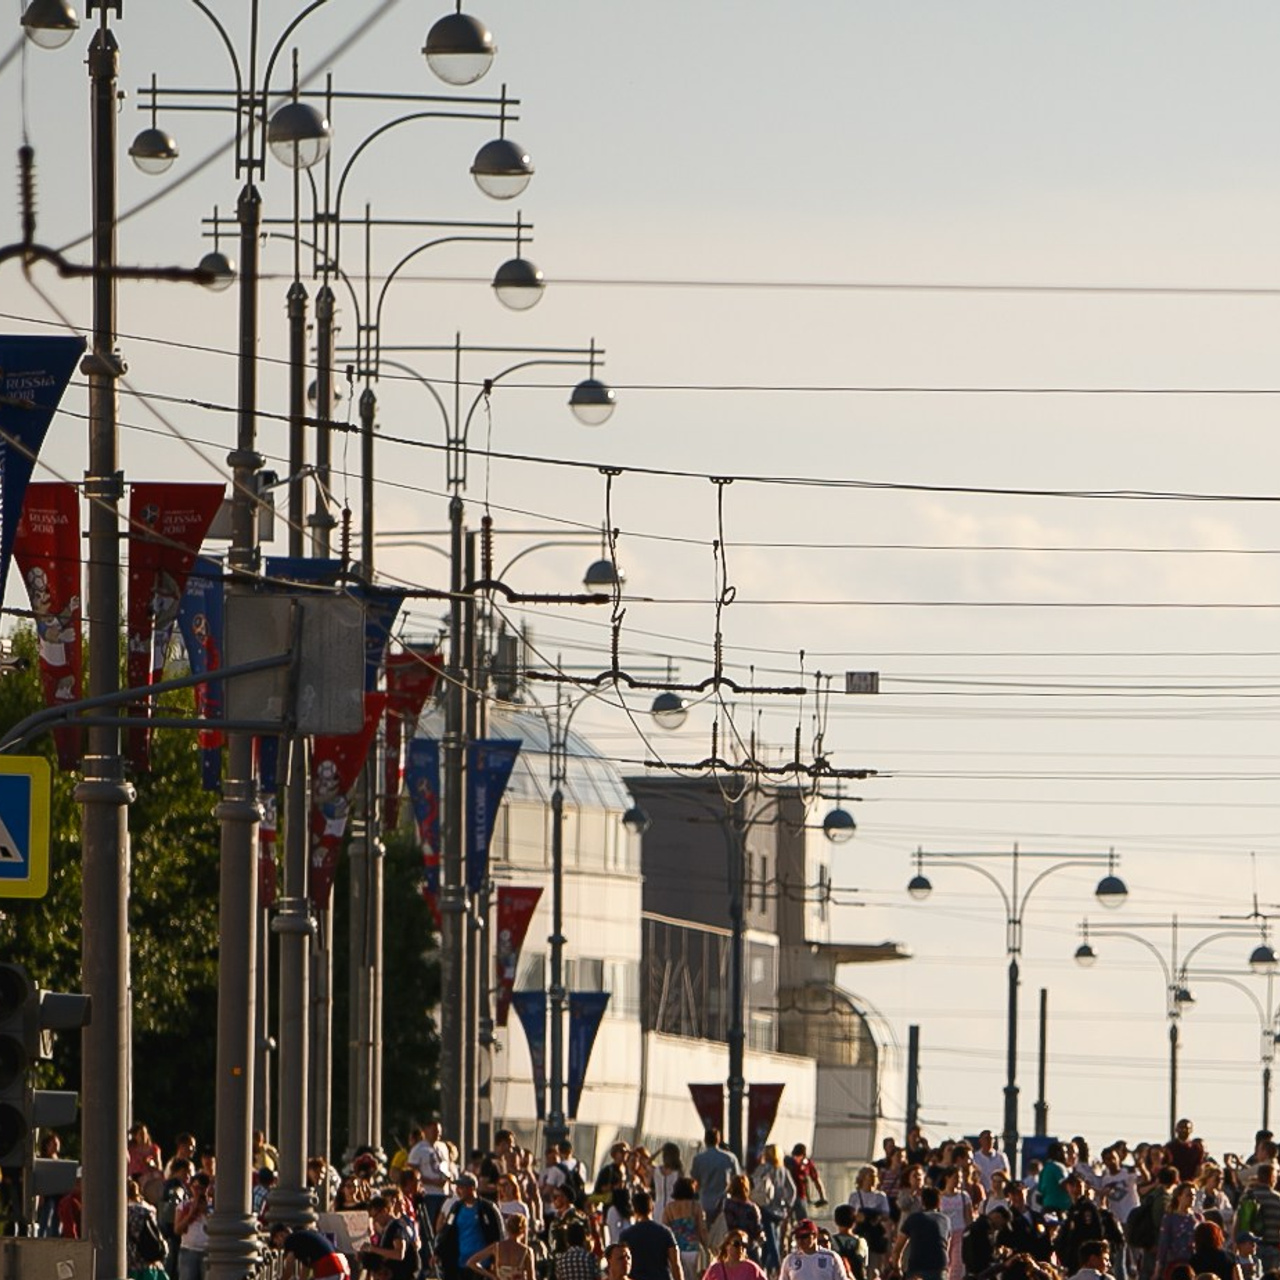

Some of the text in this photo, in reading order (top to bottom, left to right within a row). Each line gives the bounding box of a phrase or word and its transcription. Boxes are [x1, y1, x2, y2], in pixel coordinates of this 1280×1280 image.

[6, 376, 55, 389] RUSSIA
[29, 513, 69, 525] RUSSIA
[162, 514, 202, 526] RUSSIA
[32, 523, 54, 534] 2018
